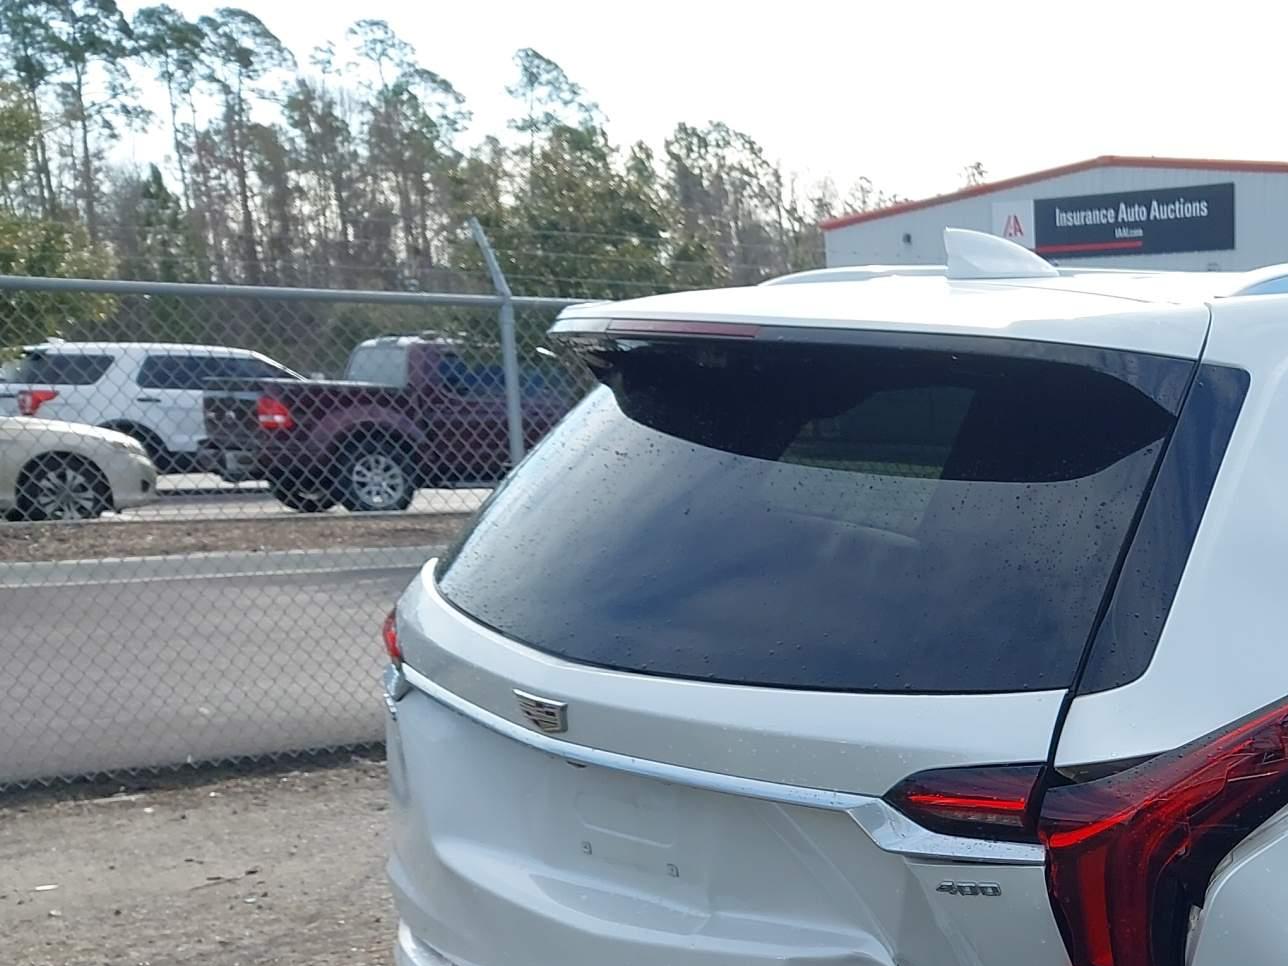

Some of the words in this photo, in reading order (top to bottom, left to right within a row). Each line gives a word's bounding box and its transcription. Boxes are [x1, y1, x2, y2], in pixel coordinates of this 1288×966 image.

[1055, 206, 1115, 227] Insurance
[1117, 202, 1147, 223] Auto
[1149, 198, 1208, 221] Auctions
[936, 880, 1002, 897] 400
